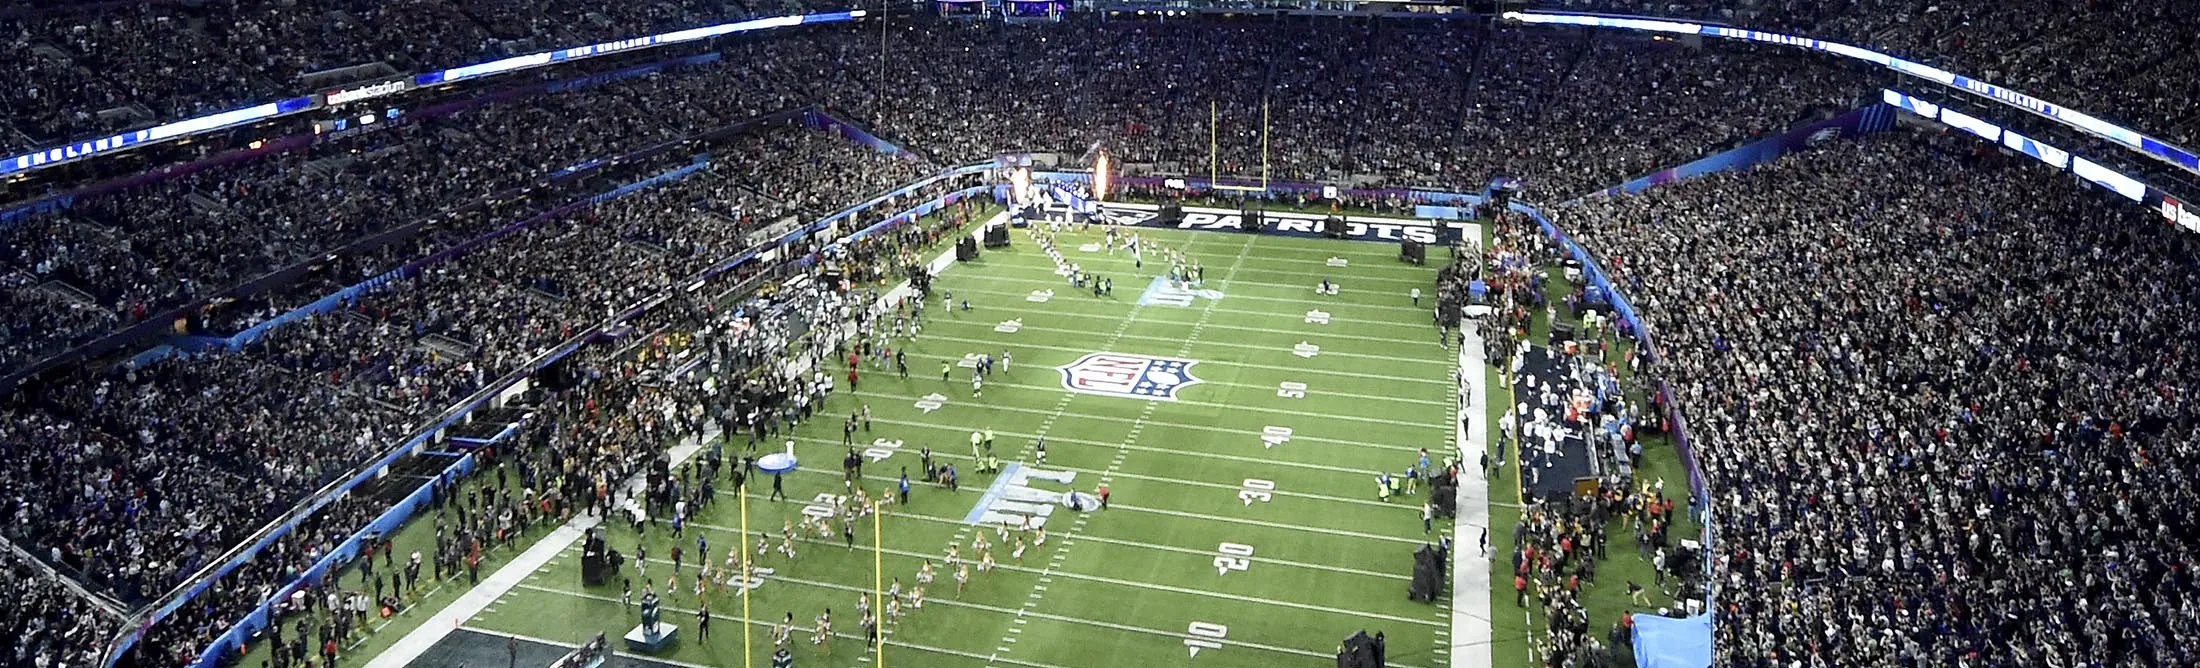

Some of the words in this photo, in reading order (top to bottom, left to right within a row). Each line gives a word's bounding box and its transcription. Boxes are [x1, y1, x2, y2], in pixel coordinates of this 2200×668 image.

[17, 135, 124, 169] ENGLAND
[1078, 357, 1145, 388] NFL
[1277, 381, 1308, 399] 50
[1260, 425, 1293, 445] 40
[864, 438, 904, 459] 30
[1238, 478, 1276, 502] 30
[1213, 541, 1255, 571] 20
[1183, 621, 1228, 650] 10
